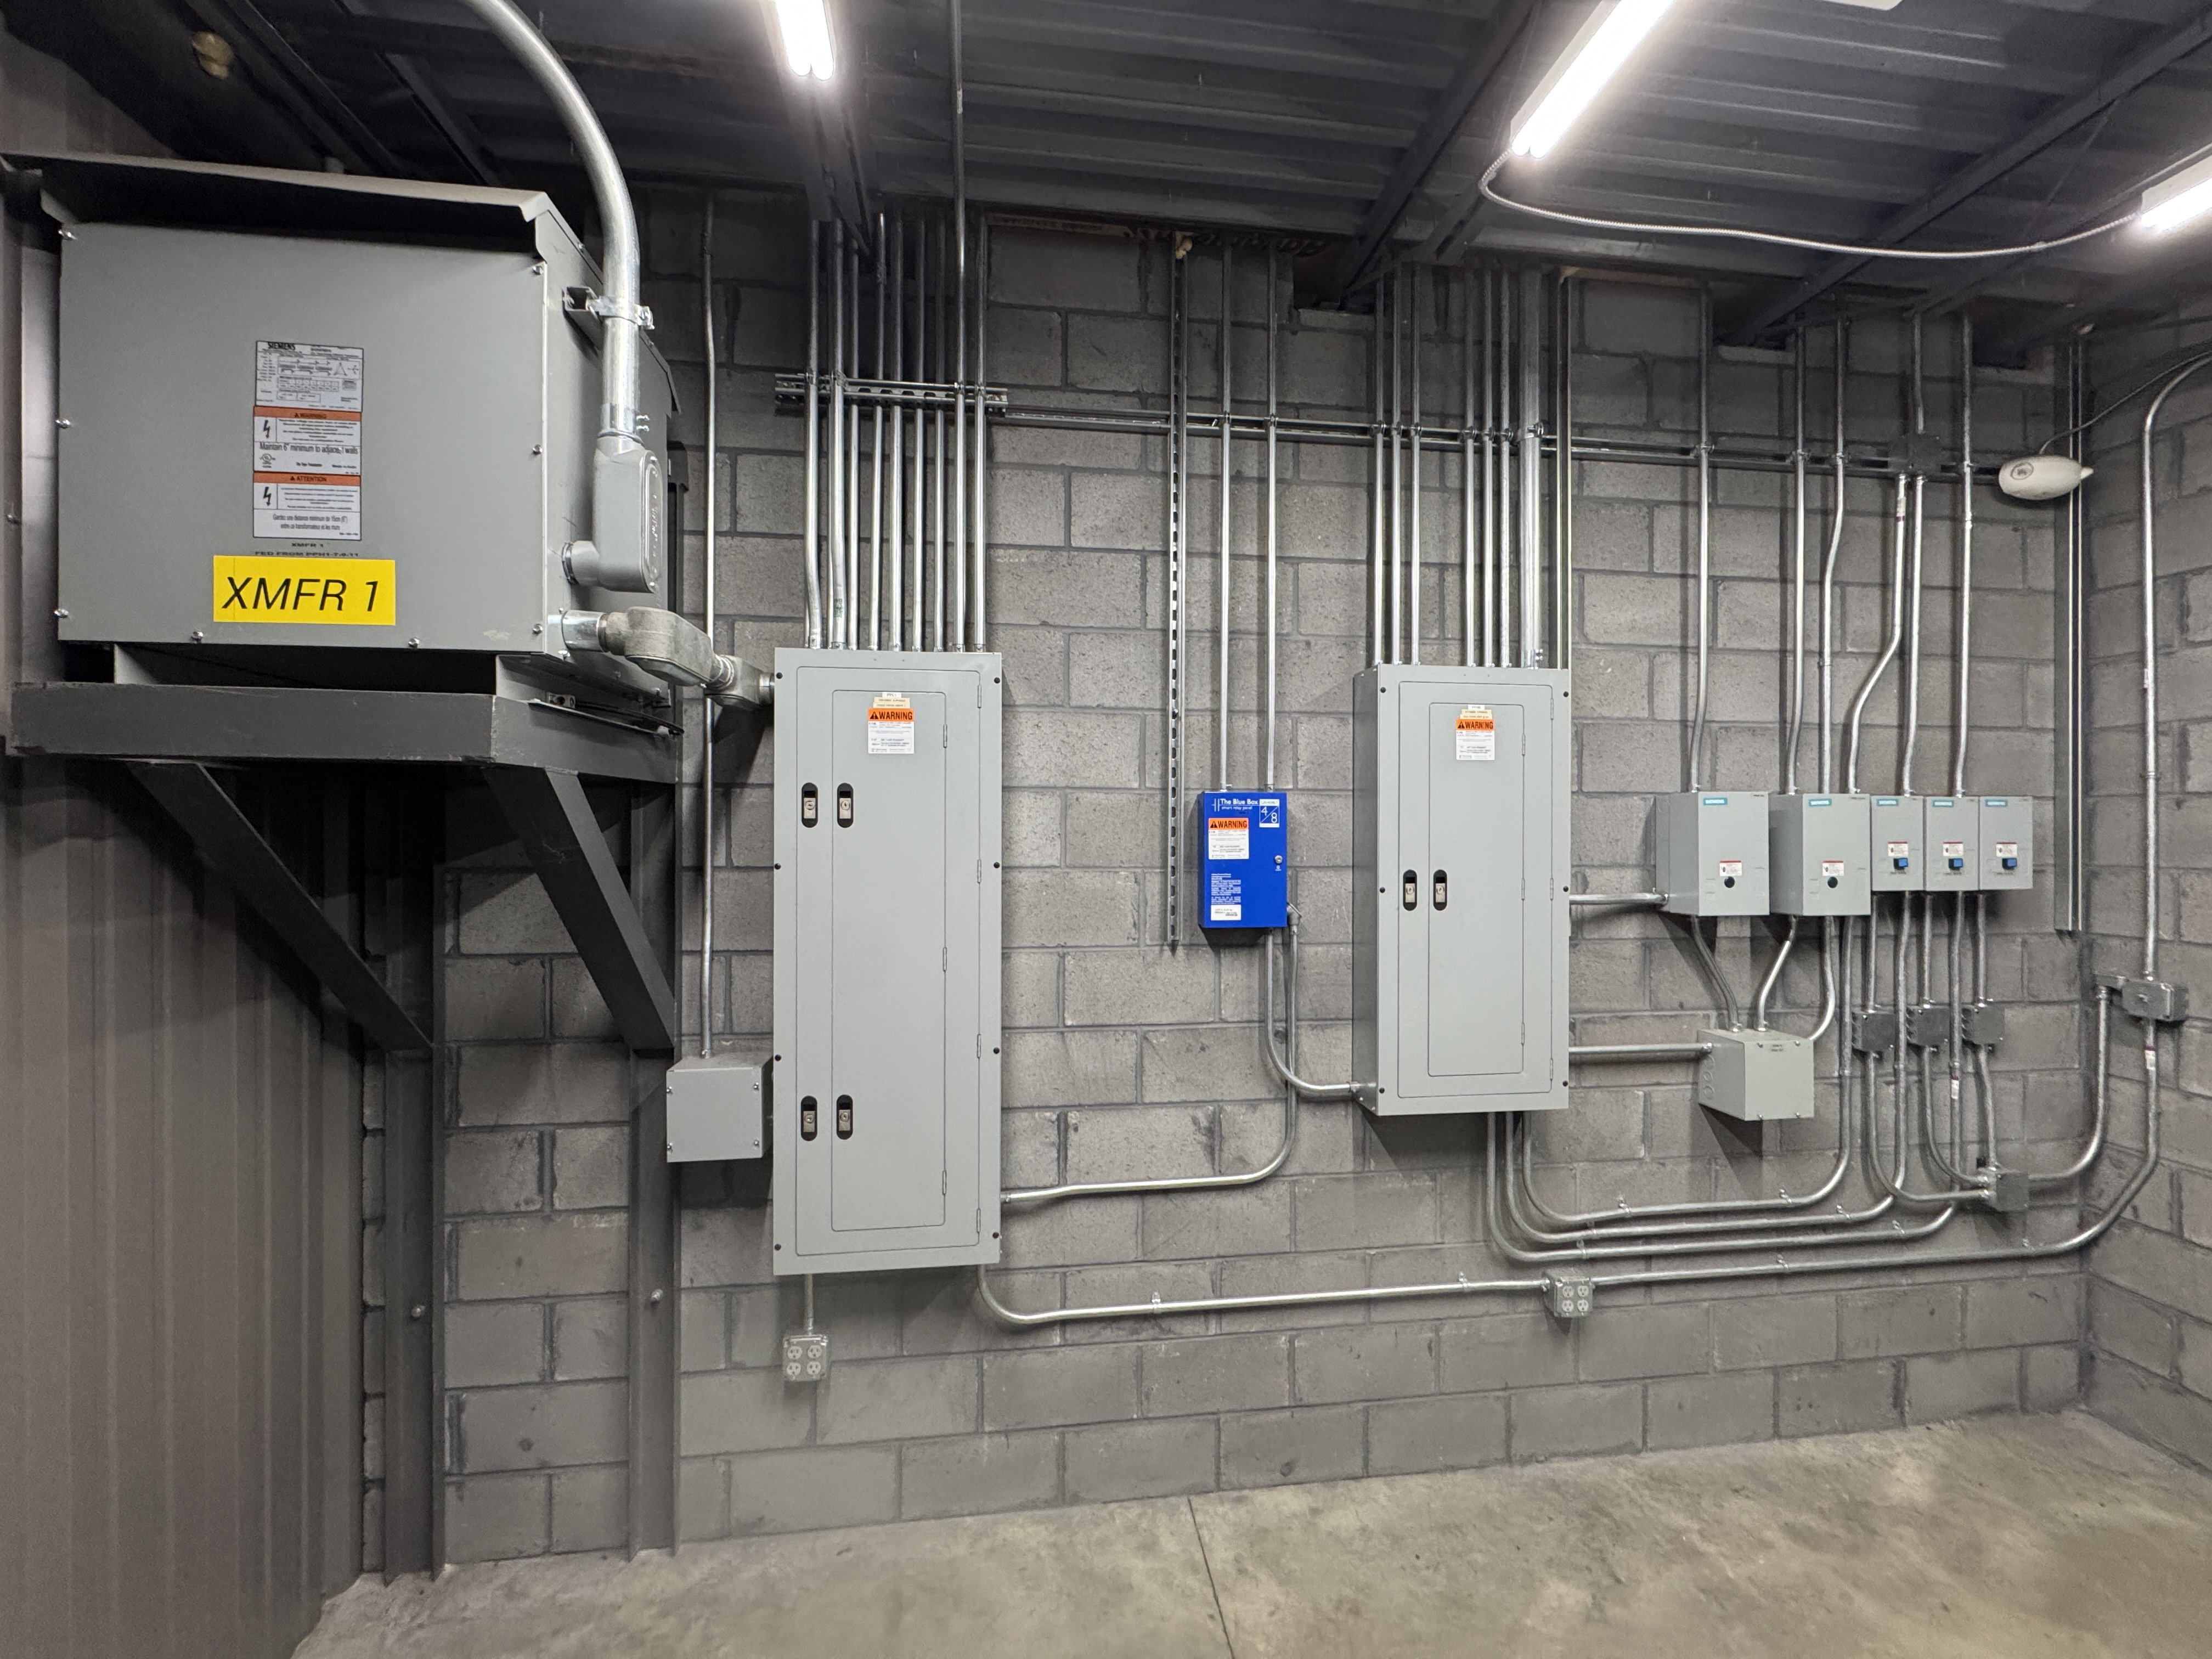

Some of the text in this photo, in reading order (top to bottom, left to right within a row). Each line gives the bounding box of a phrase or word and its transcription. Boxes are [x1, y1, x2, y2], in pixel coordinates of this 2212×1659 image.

[267, 342, 296, 351] SIEMENS
[259, 441, 282, 451] Maintain
[290, 444, 314, 453] minimum
[221, 577, 379, 612] XMFR 1
[879, 712, 913, 720] WARNING
[1465, 721, 1494, 730] WARNING
[1261, 806, 1268, 816] 4
[1271, 812, 1278, 823] 8
[1217, 820, 1248, 829] WARNING
